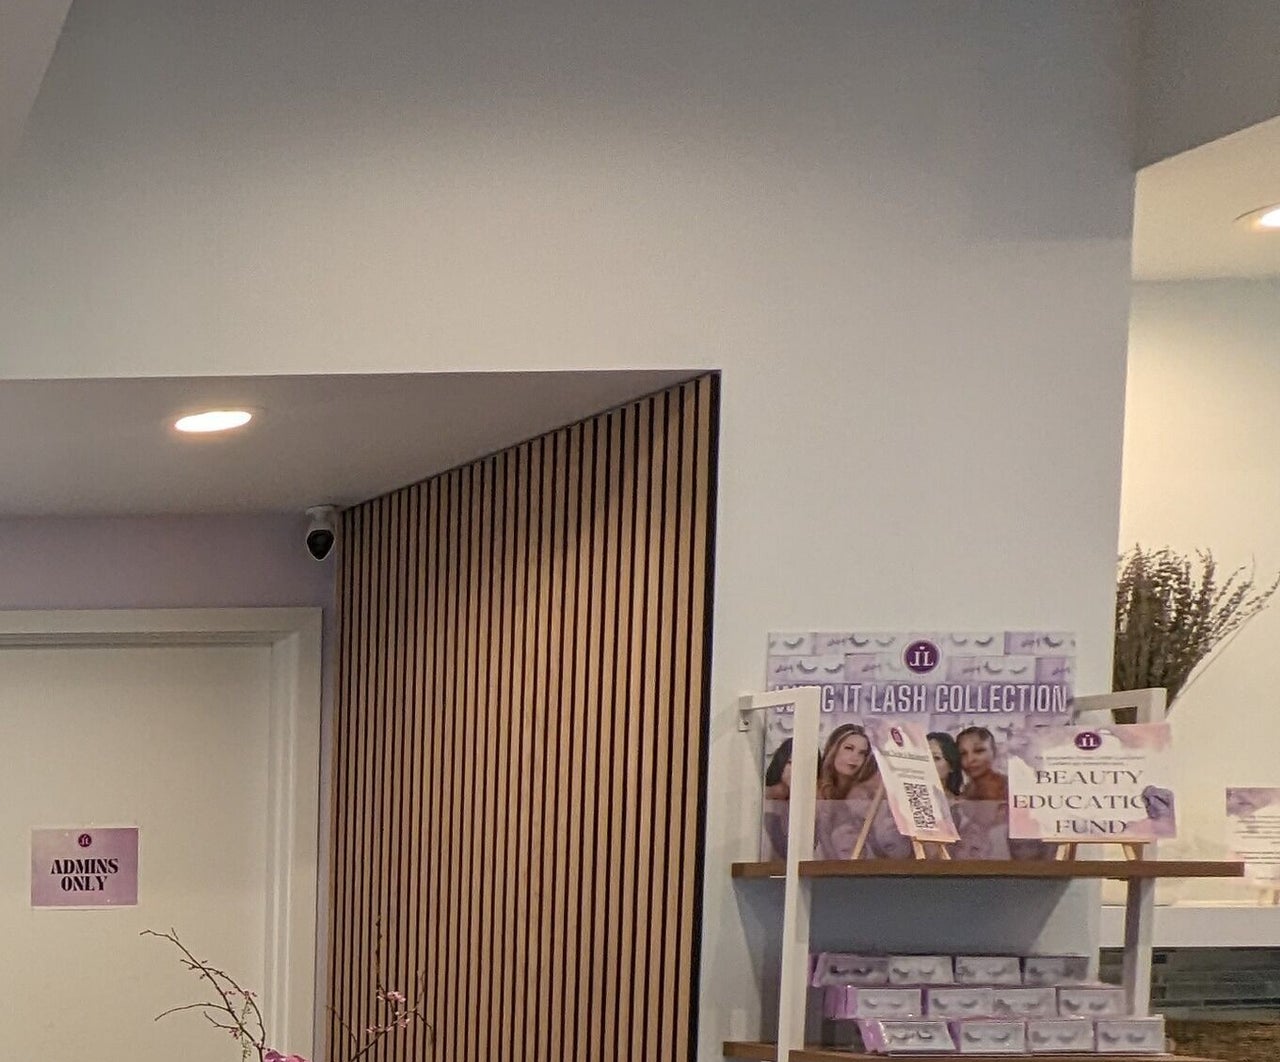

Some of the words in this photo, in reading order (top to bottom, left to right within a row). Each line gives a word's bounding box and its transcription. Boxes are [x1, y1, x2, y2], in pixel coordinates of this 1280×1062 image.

[843, 685, 861, 713] IT
[871, 685, 927, 713] LASH
[935, 684, 1067, 713] COLLECTION
[1036, 769, 1143, 785] BEAUTY
[1055, 819, 1127, 834] FUND
[51, 858, 119, 875] ADMINS
[61, 875, 107, 892] ONLY
